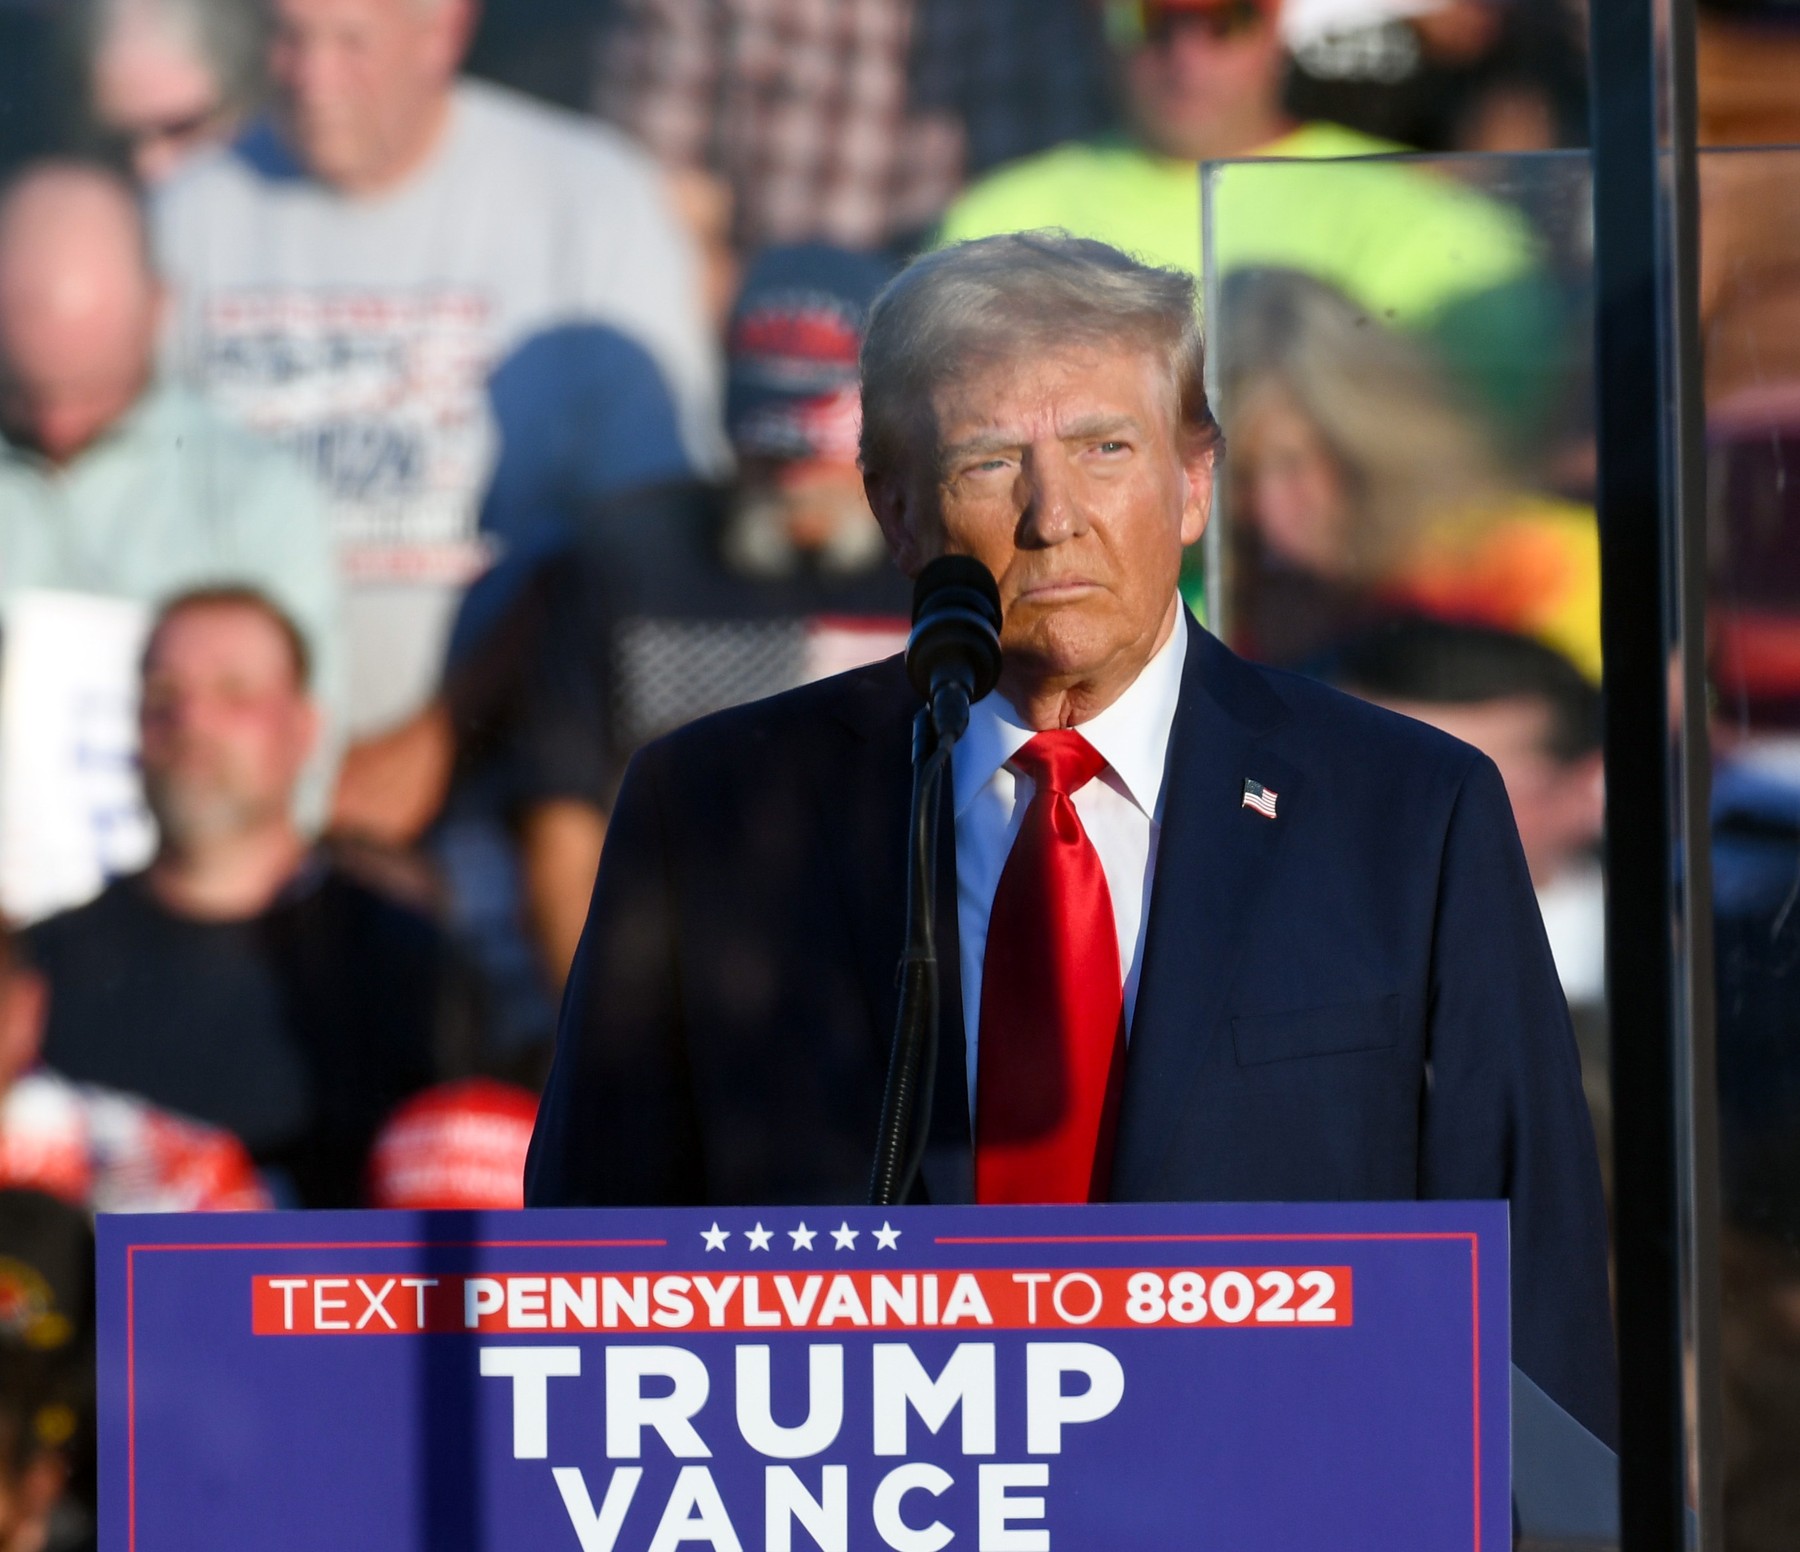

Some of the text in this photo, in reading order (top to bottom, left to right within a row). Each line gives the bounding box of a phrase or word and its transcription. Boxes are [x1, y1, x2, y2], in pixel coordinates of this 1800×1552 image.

[269, 1270, 1337, 1330] TEXT PENNSYLVANIA TO 88022
[480, 1343, 1125, 1460] TRUMP
[551, 1462, 1050, 1552] VANCE
